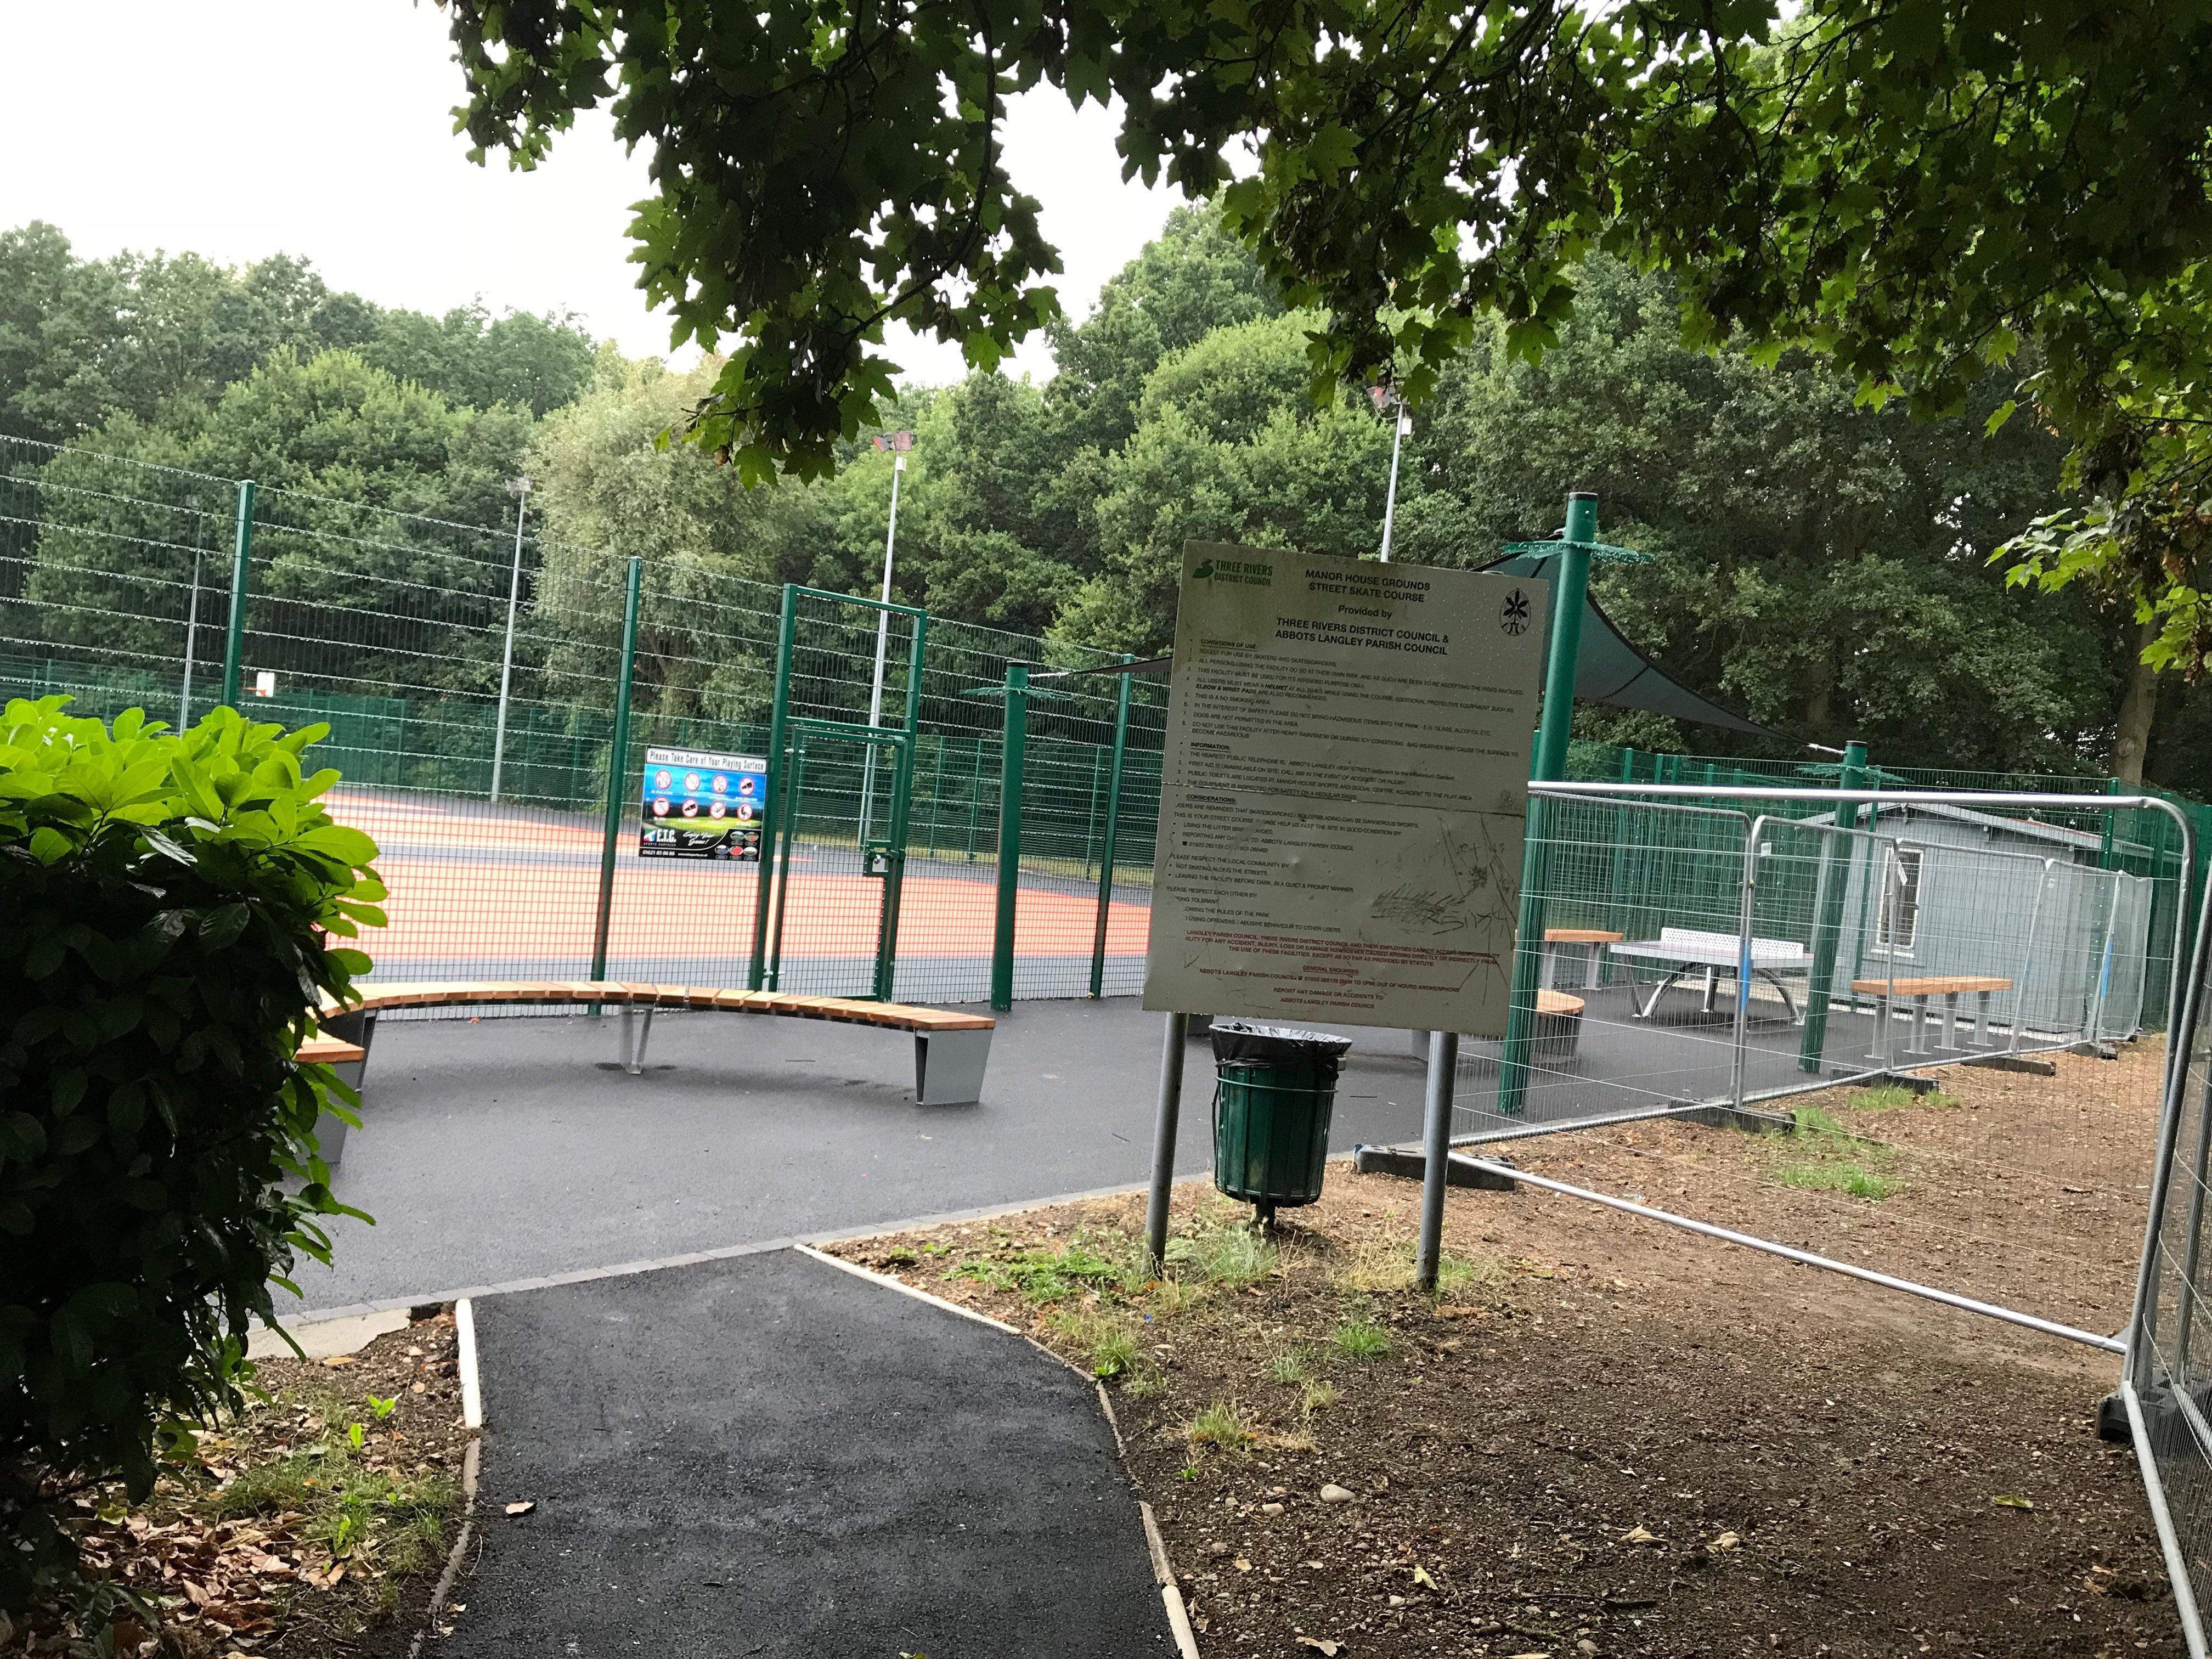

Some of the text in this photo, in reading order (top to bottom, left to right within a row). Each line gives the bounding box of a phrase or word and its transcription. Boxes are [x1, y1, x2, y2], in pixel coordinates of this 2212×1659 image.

[1215, 559, 1273, 577] THREE RIVERS
[1214, 572, 1272, 586] DISTRICT COUNCIL
[1305, 568, 1430, 591] MANOR HOUSE GROUNDS
[1308, 582, 1424, 602] STREET SKATE COURSE
[1338, 604, 1392, 619] Provided by
[1276, 617, 1449, 644] THREE RIVERS DISTRICT COUNCIL &
[1200, 639, 1235, 647] CONDITIONS
[1274, 629, 1448, 655] ABBOTS LANGLEY PARISH COUNCIL
[650, 751, 764, 770] Please Take Care of Your Playing Surface
[657, 829, 676, 843] E.T.C.
[682, 831, 700, 840] Enjoy
